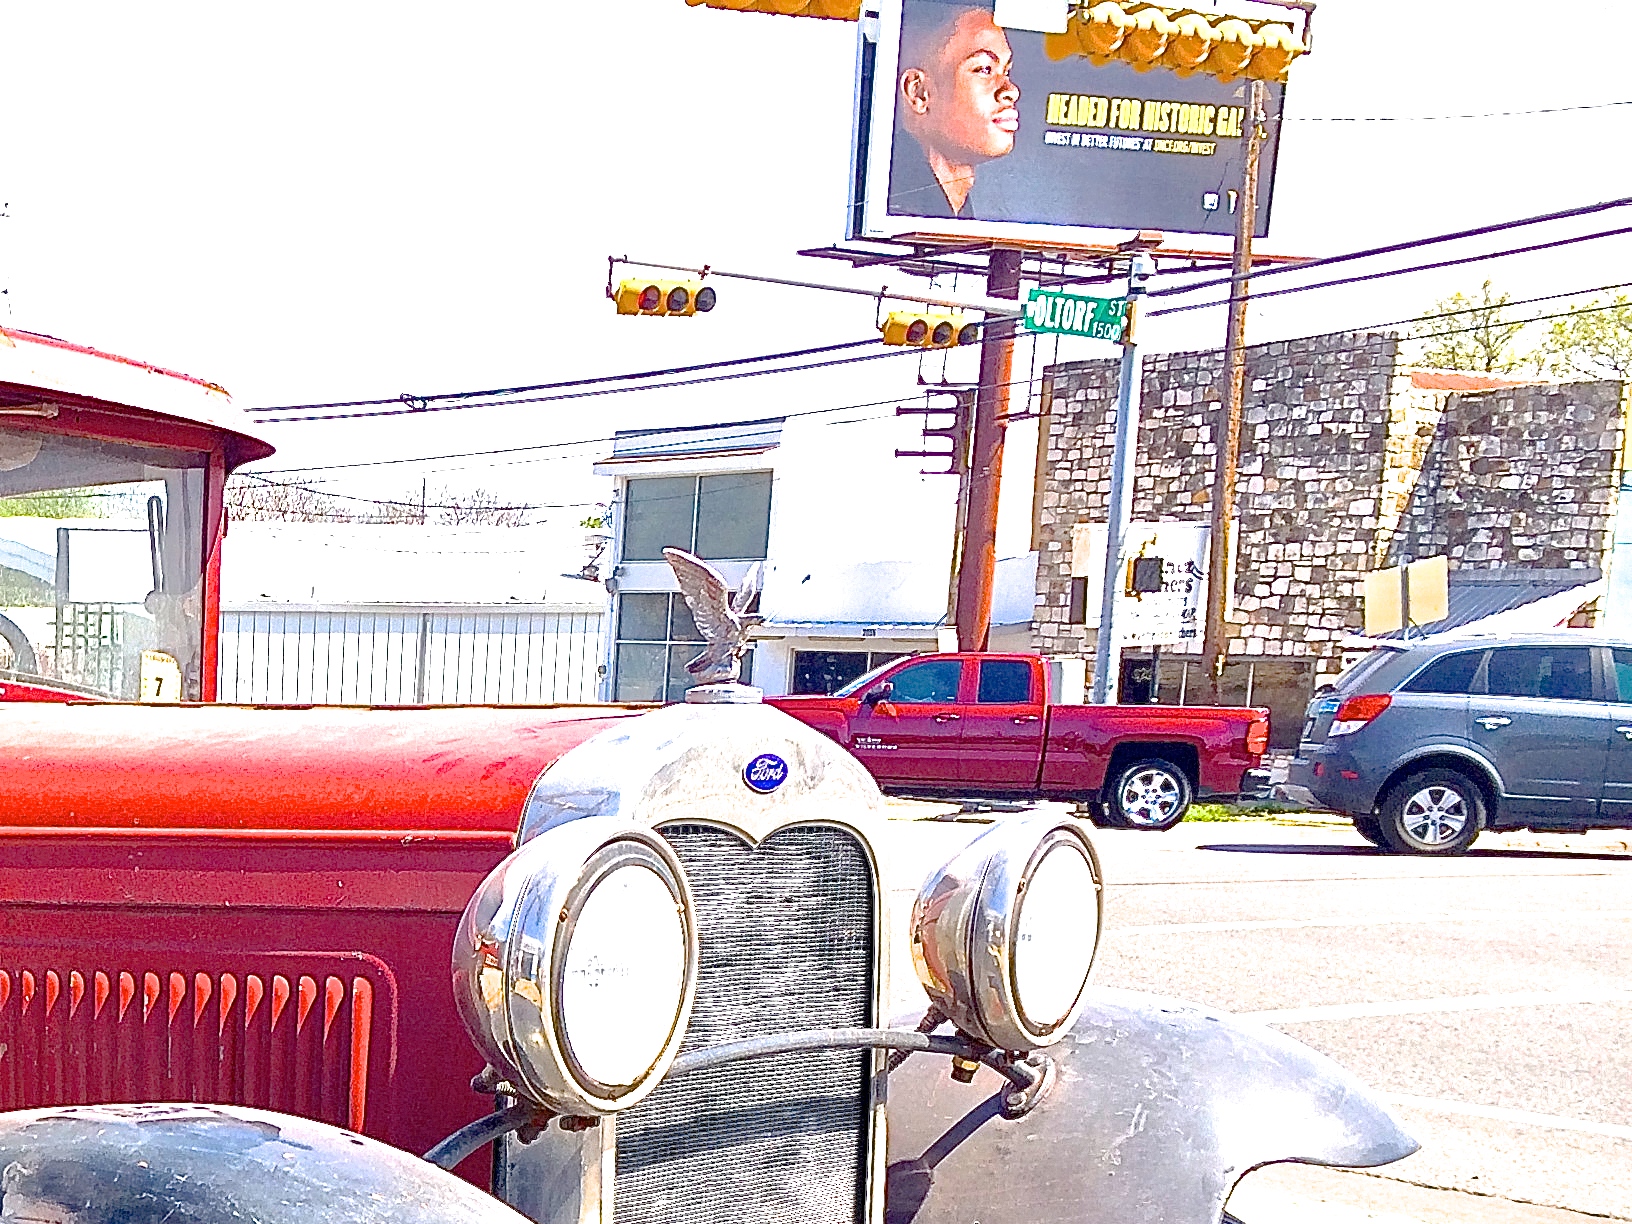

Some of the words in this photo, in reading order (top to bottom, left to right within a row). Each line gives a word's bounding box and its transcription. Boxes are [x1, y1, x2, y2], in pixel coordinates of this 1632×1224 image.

[1046, 93, 1109, 129] HEADED
[1109, 98, 1142, 131] FOR
[1143, 101, 1216, 135] HISTORIC
[1033, 295, 1098, 333] OLTORF
[1109, 300, 1127, 318] ST
[750, 758, 785, 781] Ford
